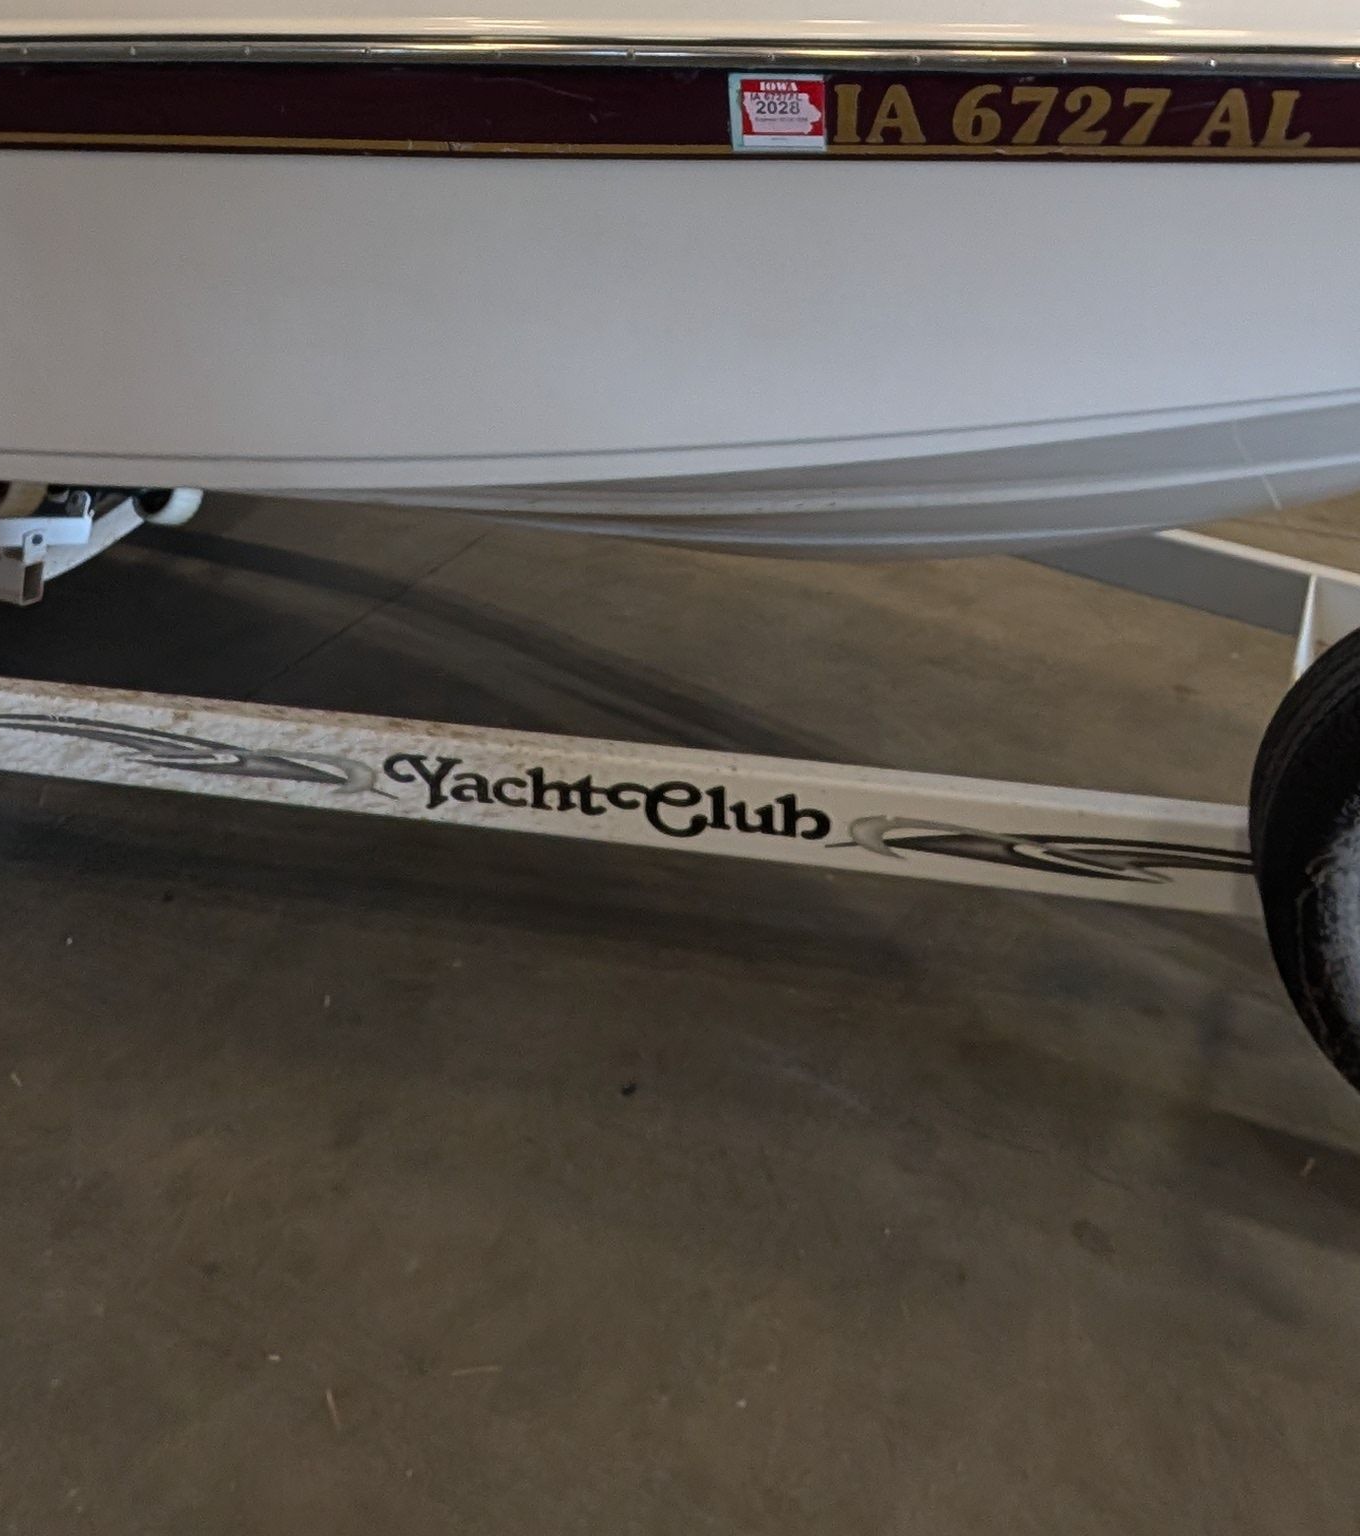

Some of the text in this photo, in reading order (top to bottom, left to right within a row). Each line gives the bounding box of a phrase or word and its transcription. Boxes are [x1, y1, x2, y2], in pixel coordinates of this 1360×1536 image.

[759, 81, 798, 92] IOWA
[755, 100, 801, 115] 2028
[833, 83, 1313, 148] IA 6727 AL
